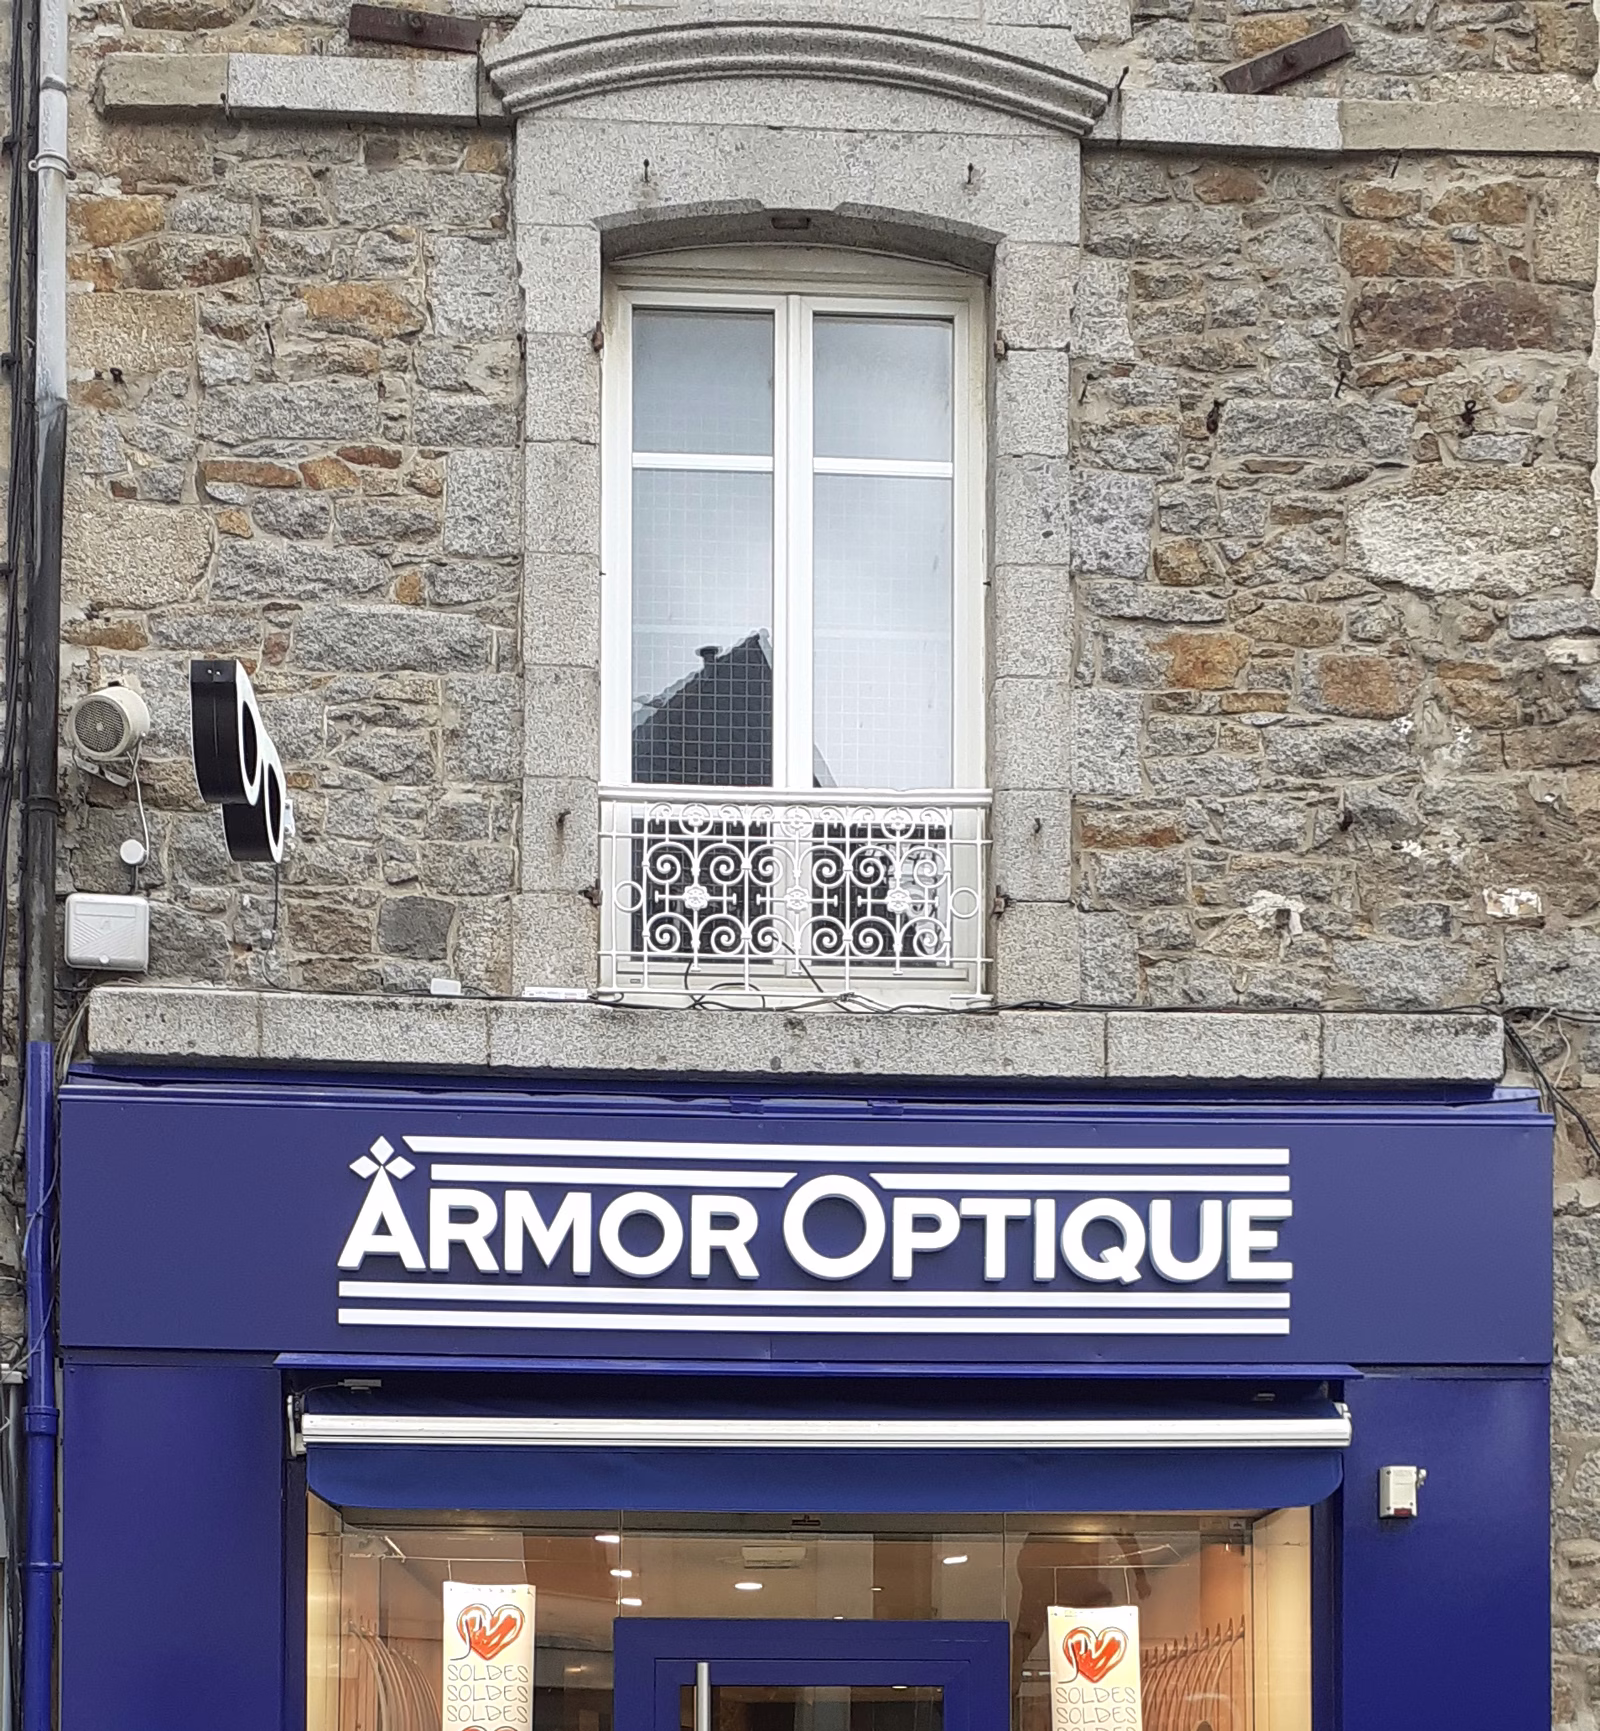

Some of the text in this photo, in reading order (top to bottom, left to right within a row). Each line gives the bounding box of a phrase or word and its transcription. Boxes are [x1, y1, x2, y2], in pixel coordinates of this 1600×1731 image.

[337, 1165, 1294, 1286] ARMOR OPTIQUE
[447, 1664, 529, 1683] SOLDES
[447, 1684, 528, 1703] SOLDES
[1055, 1686, 1136, 1705] SOLDES
[446, 1704, 528, 1724] SOLDES
[1056, 1706, 1137, 1724] SOLDES
